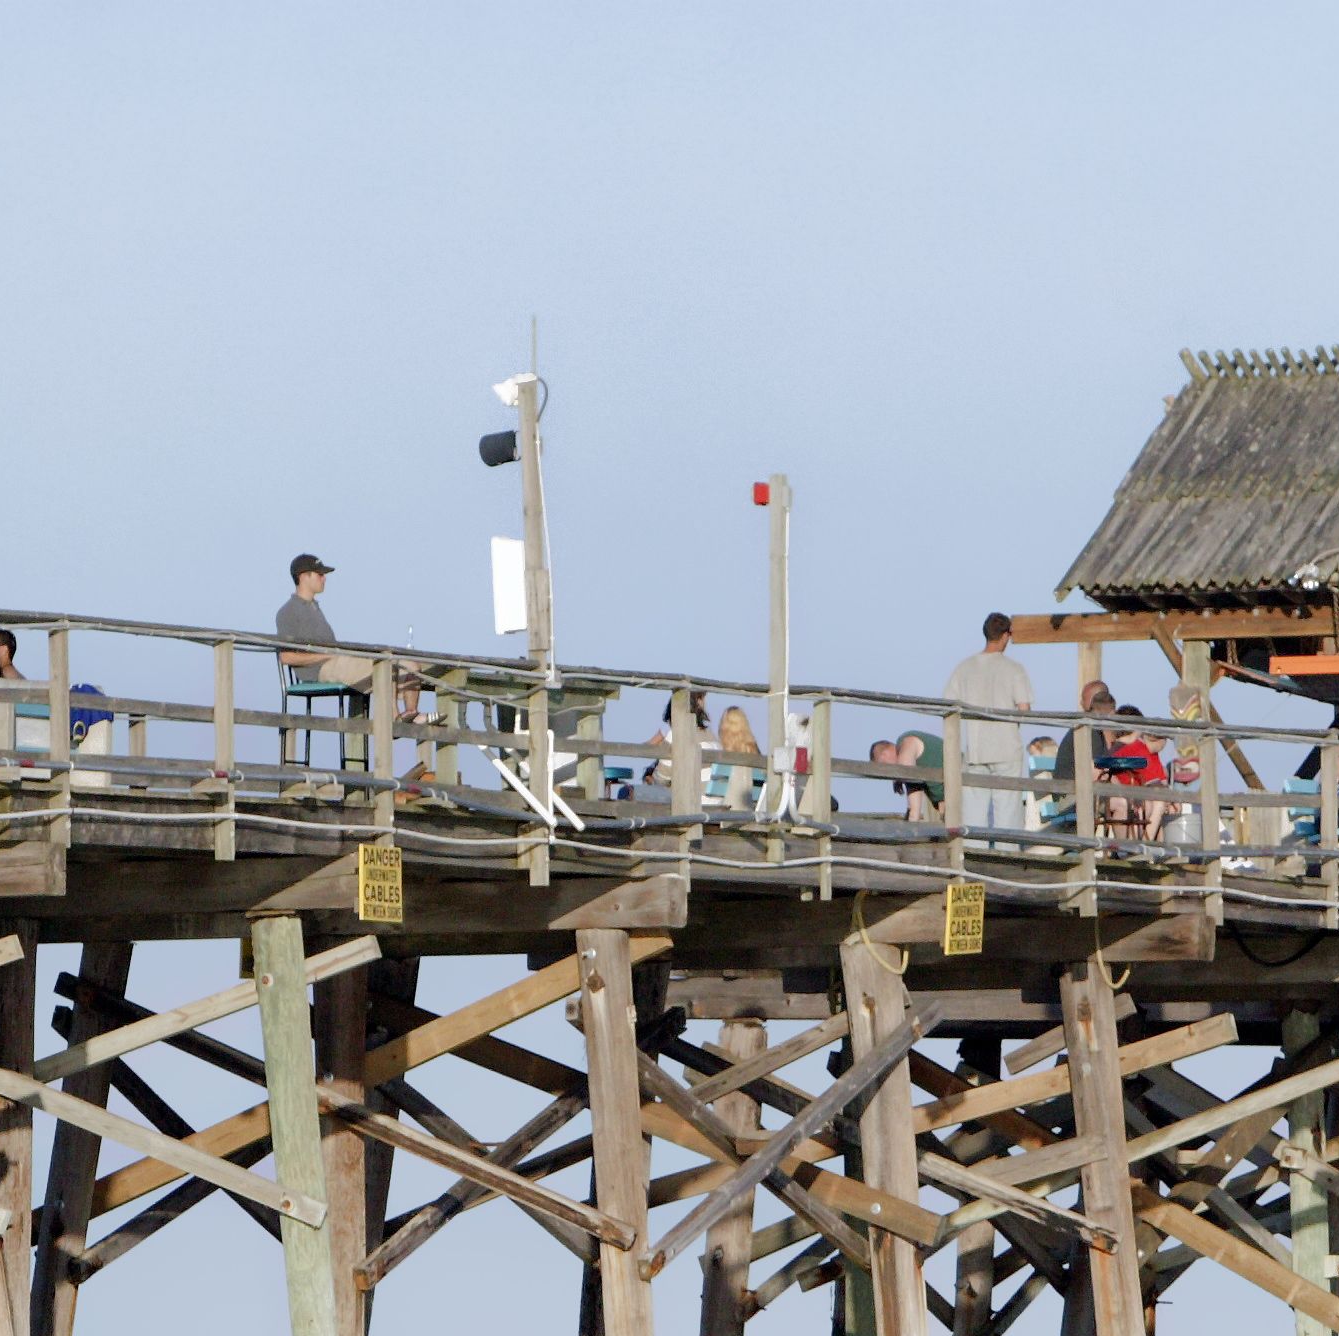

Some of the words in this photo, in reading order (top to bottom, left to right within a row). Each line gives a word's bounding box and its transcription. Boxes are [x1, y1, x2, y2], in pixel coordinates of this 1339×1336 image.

[363, 847, 401, 868] DANGER
[363, 883, 401, 903] CABLES
[951, 885, 984, 904] DANGER
[949, 919, 982, 937] CABLES
